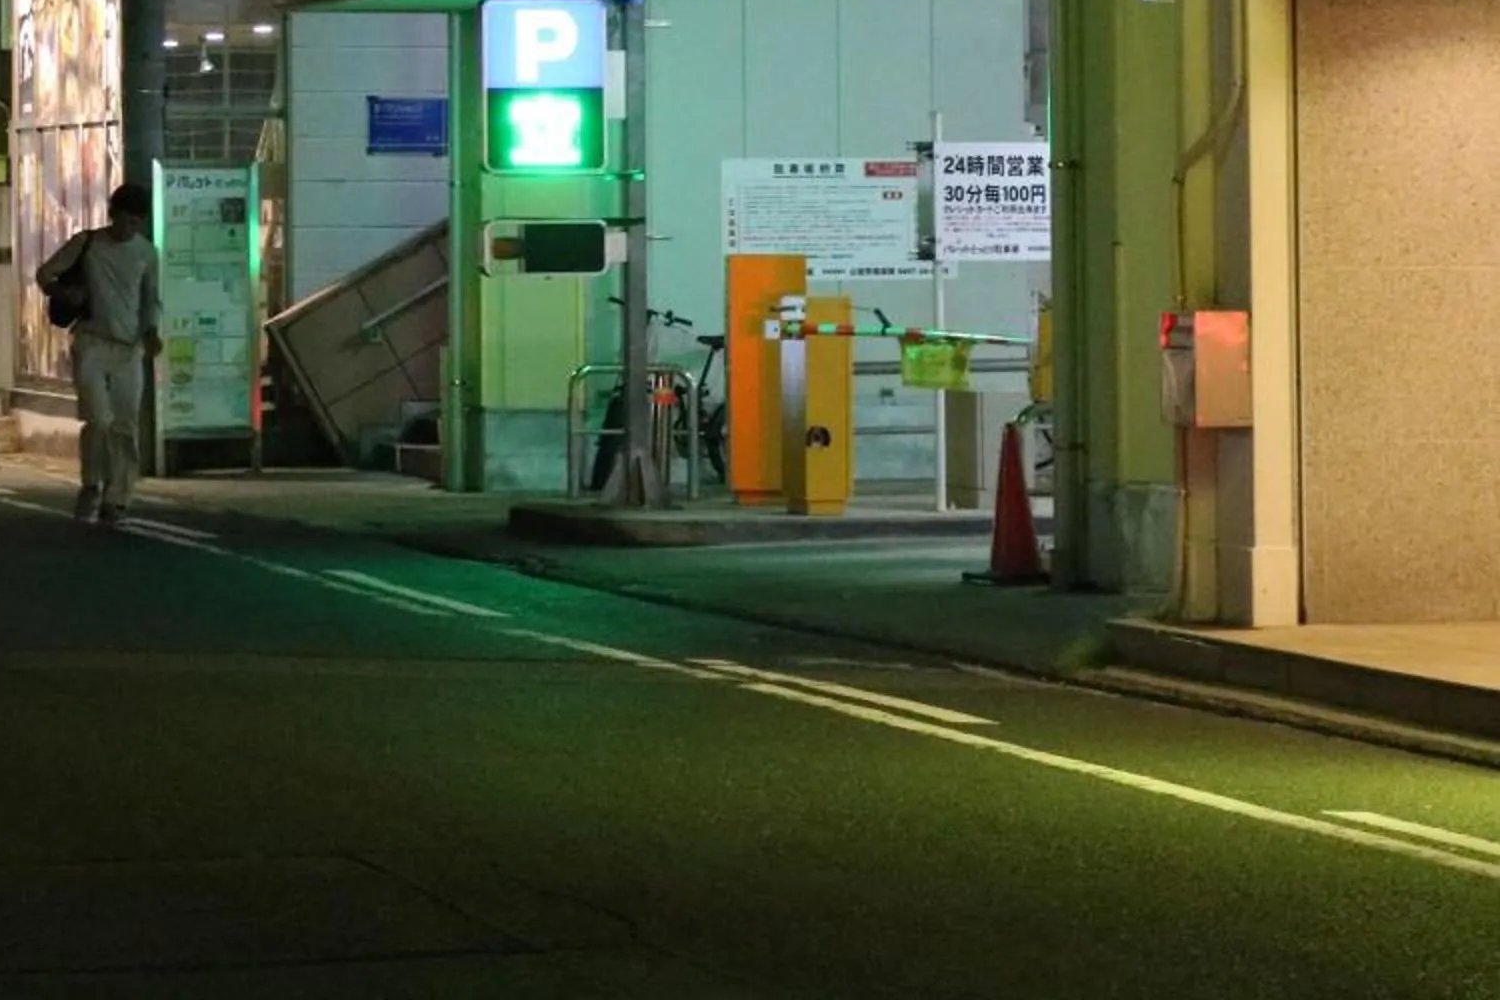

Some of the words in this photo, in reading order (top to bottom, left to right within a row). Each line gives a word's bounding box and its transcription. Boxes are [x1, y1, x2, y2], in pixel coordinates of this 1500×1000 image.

[514, 9, 579, 83] P
[943, 155, 1045, 176] 24時間営業
[943, 184, 1046, 203] 30分毎100円
